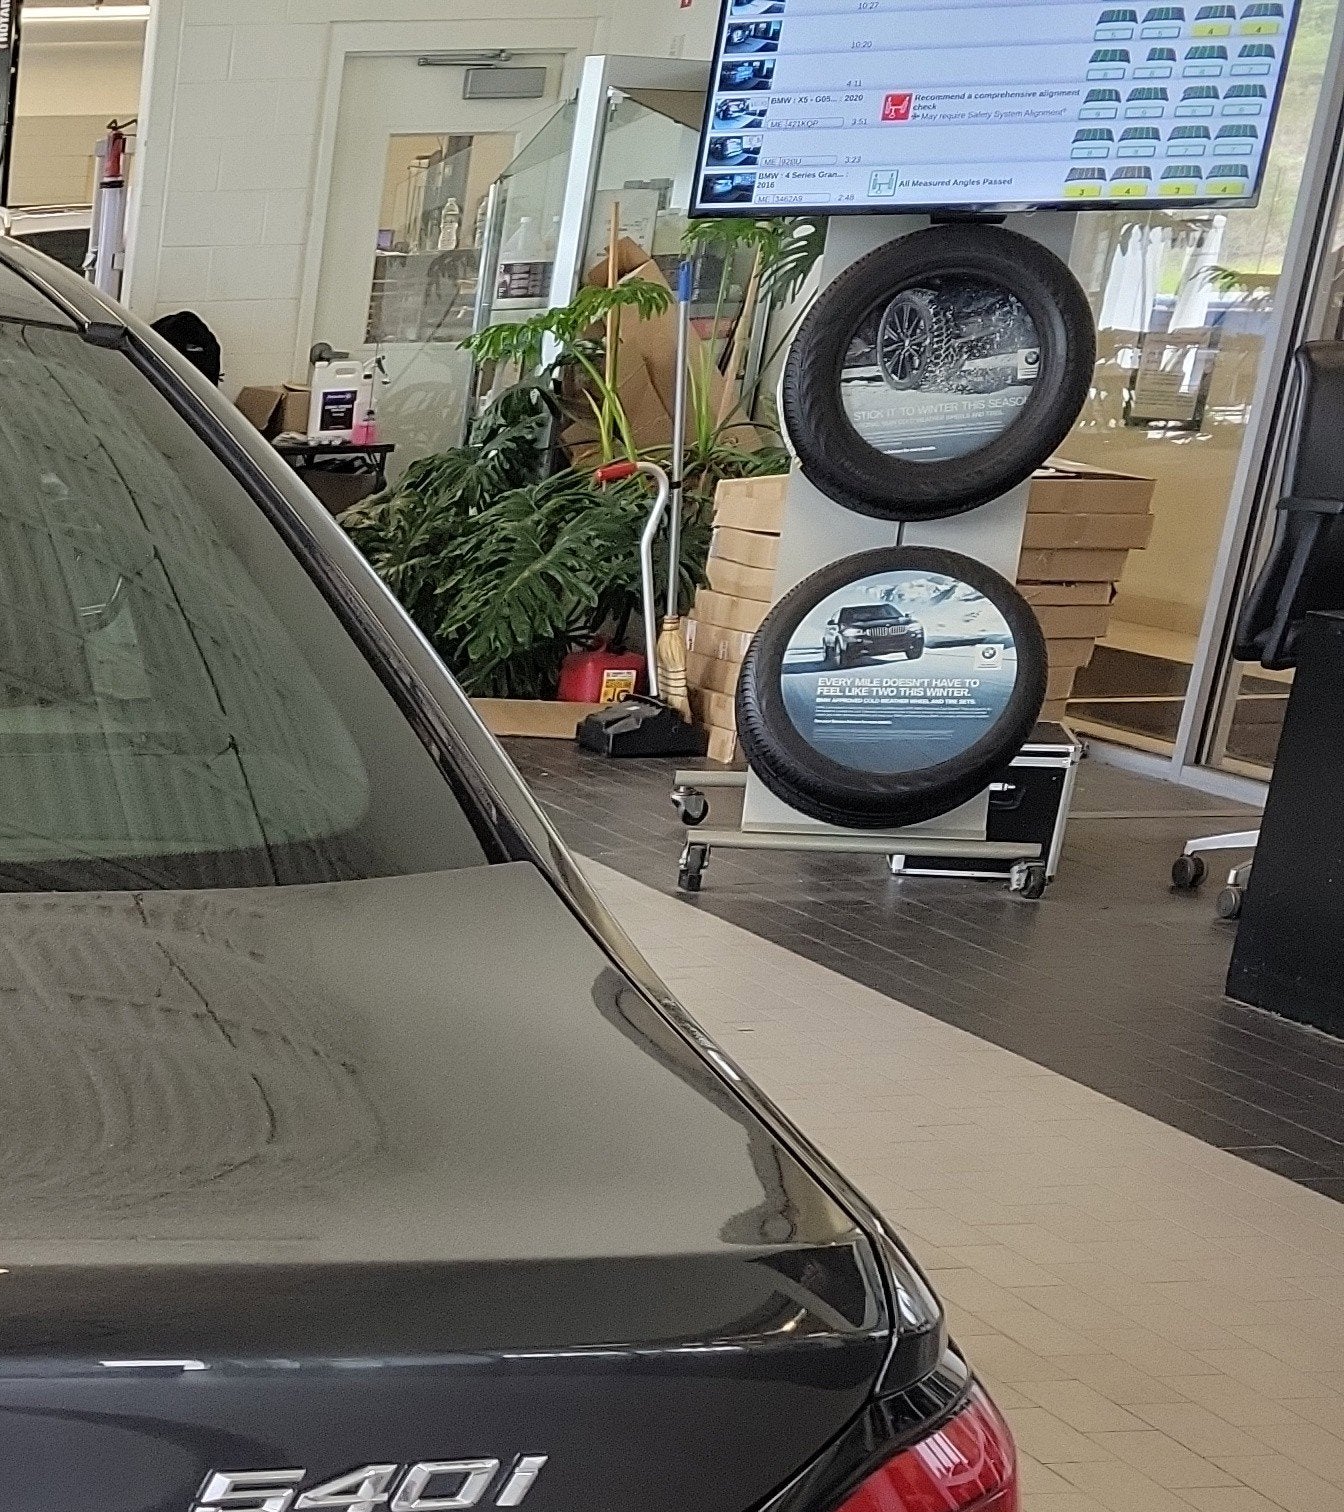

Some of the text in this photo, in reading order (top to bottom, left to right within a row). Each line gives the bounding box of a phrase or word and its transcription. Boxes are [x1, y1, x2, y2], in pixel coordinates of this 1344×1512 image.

[771, 97, 792, 105] BMW
[844, 94, 864, 102] 2020
[914, 93, 966, 101] Recommend
[974, 89, 1038, 101] comprehensive
[1038, 89, 1081, 98] alignment
[912, 103, 937, 111] check
[920, 112, 939, 121] May
[939, 111, 966, 120] require
[993, 108, 1023, 119] System
[758, 172, 780, 180] BMW
[792, 171, 817, 179] Series
[756, 181, 775, 189] 2016
[898, 177, 1013, 188] All Measured Angles Passed
[853, 410, 884, 422] STICK
[886, 407, 897, 418] IT
[902, 406, 916, 417] TO
[917, 402, 960, 415] WINTER
[961, 400, 985, 411] THIS
[818, 677, 980, 688] EVERY MILE DOESN'T HAVE TO
[816, 686, 972, 697] FEEL LIKE TWO THIS WINTER.
